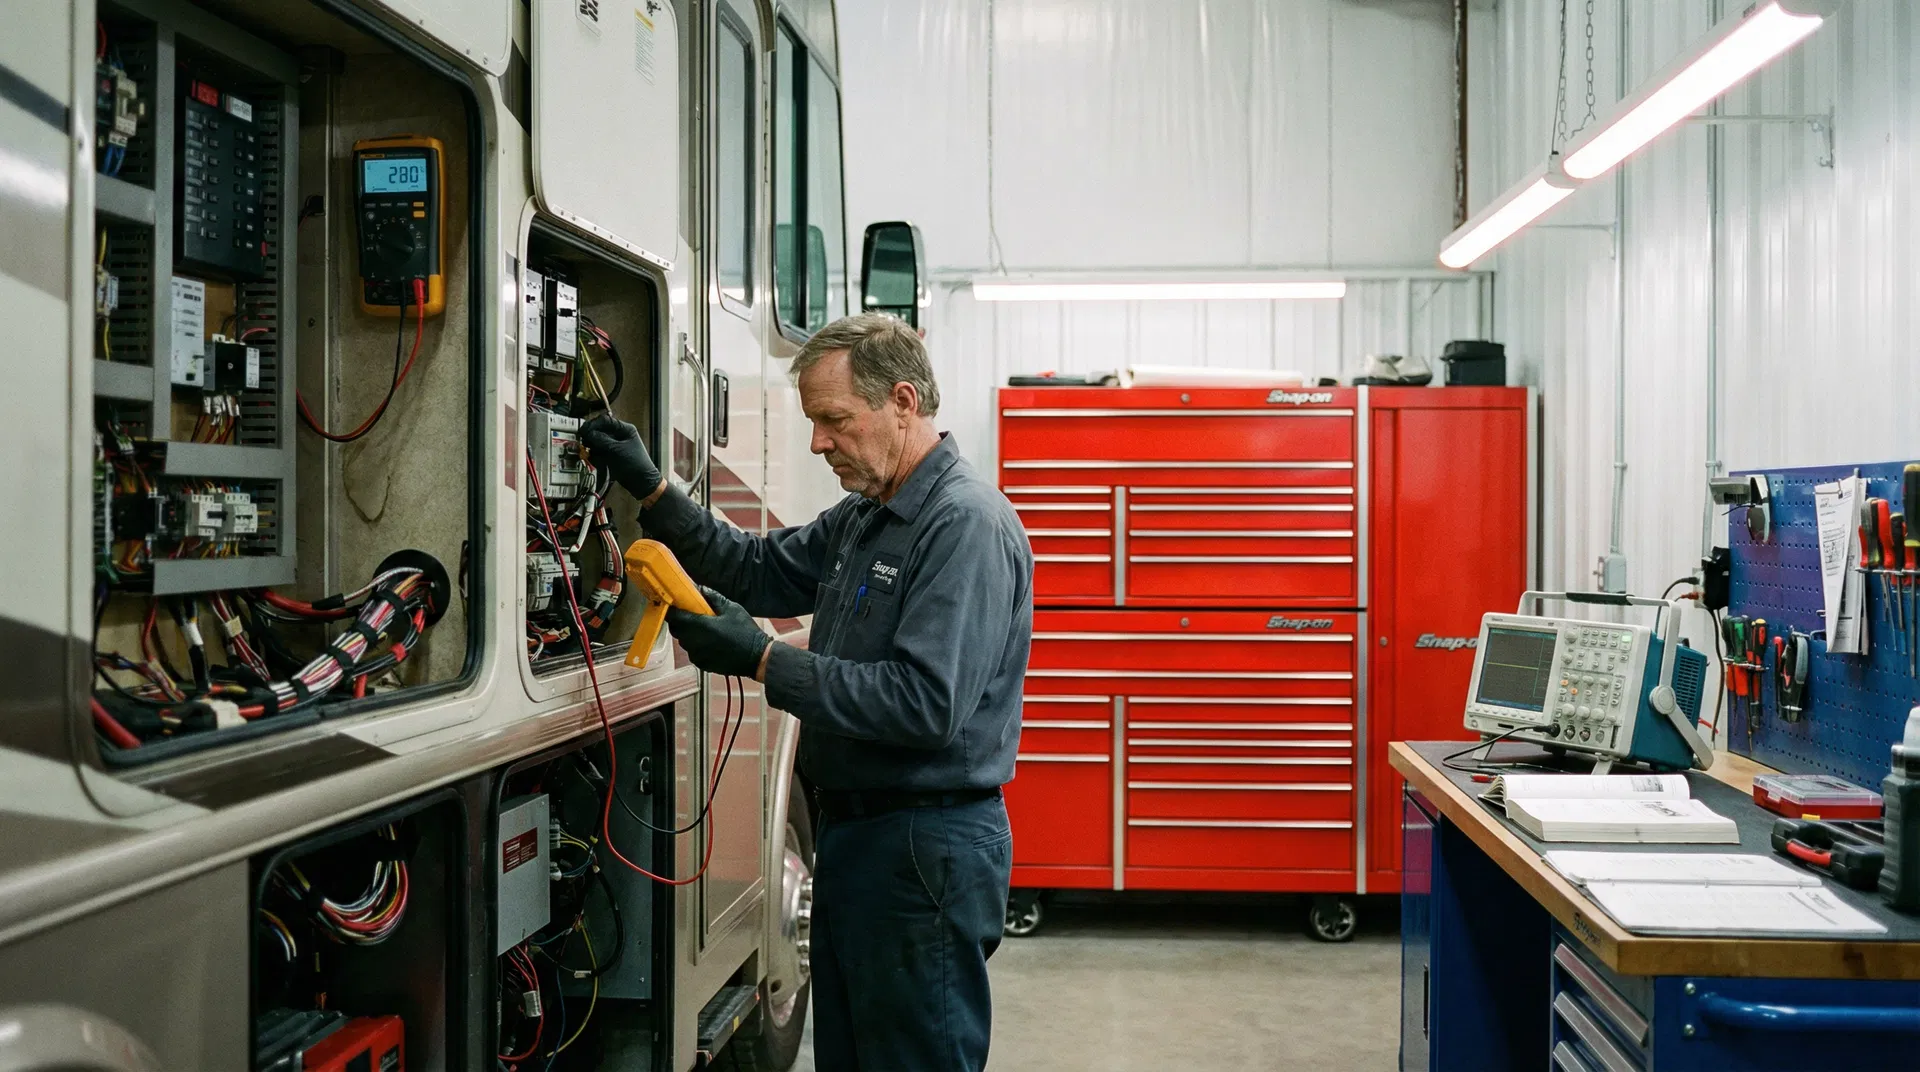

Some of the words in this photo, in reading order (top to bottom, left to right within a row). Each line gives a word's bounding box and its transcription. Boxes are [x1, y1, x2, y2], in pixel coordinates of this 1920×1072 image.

[388, 166, 419, 184] 280
[1266, 390, 1332, 405] Snap-on
[1267, 616, 1333, 630] Snap-on
[1415, 634, 1478, 650] Snap-o
